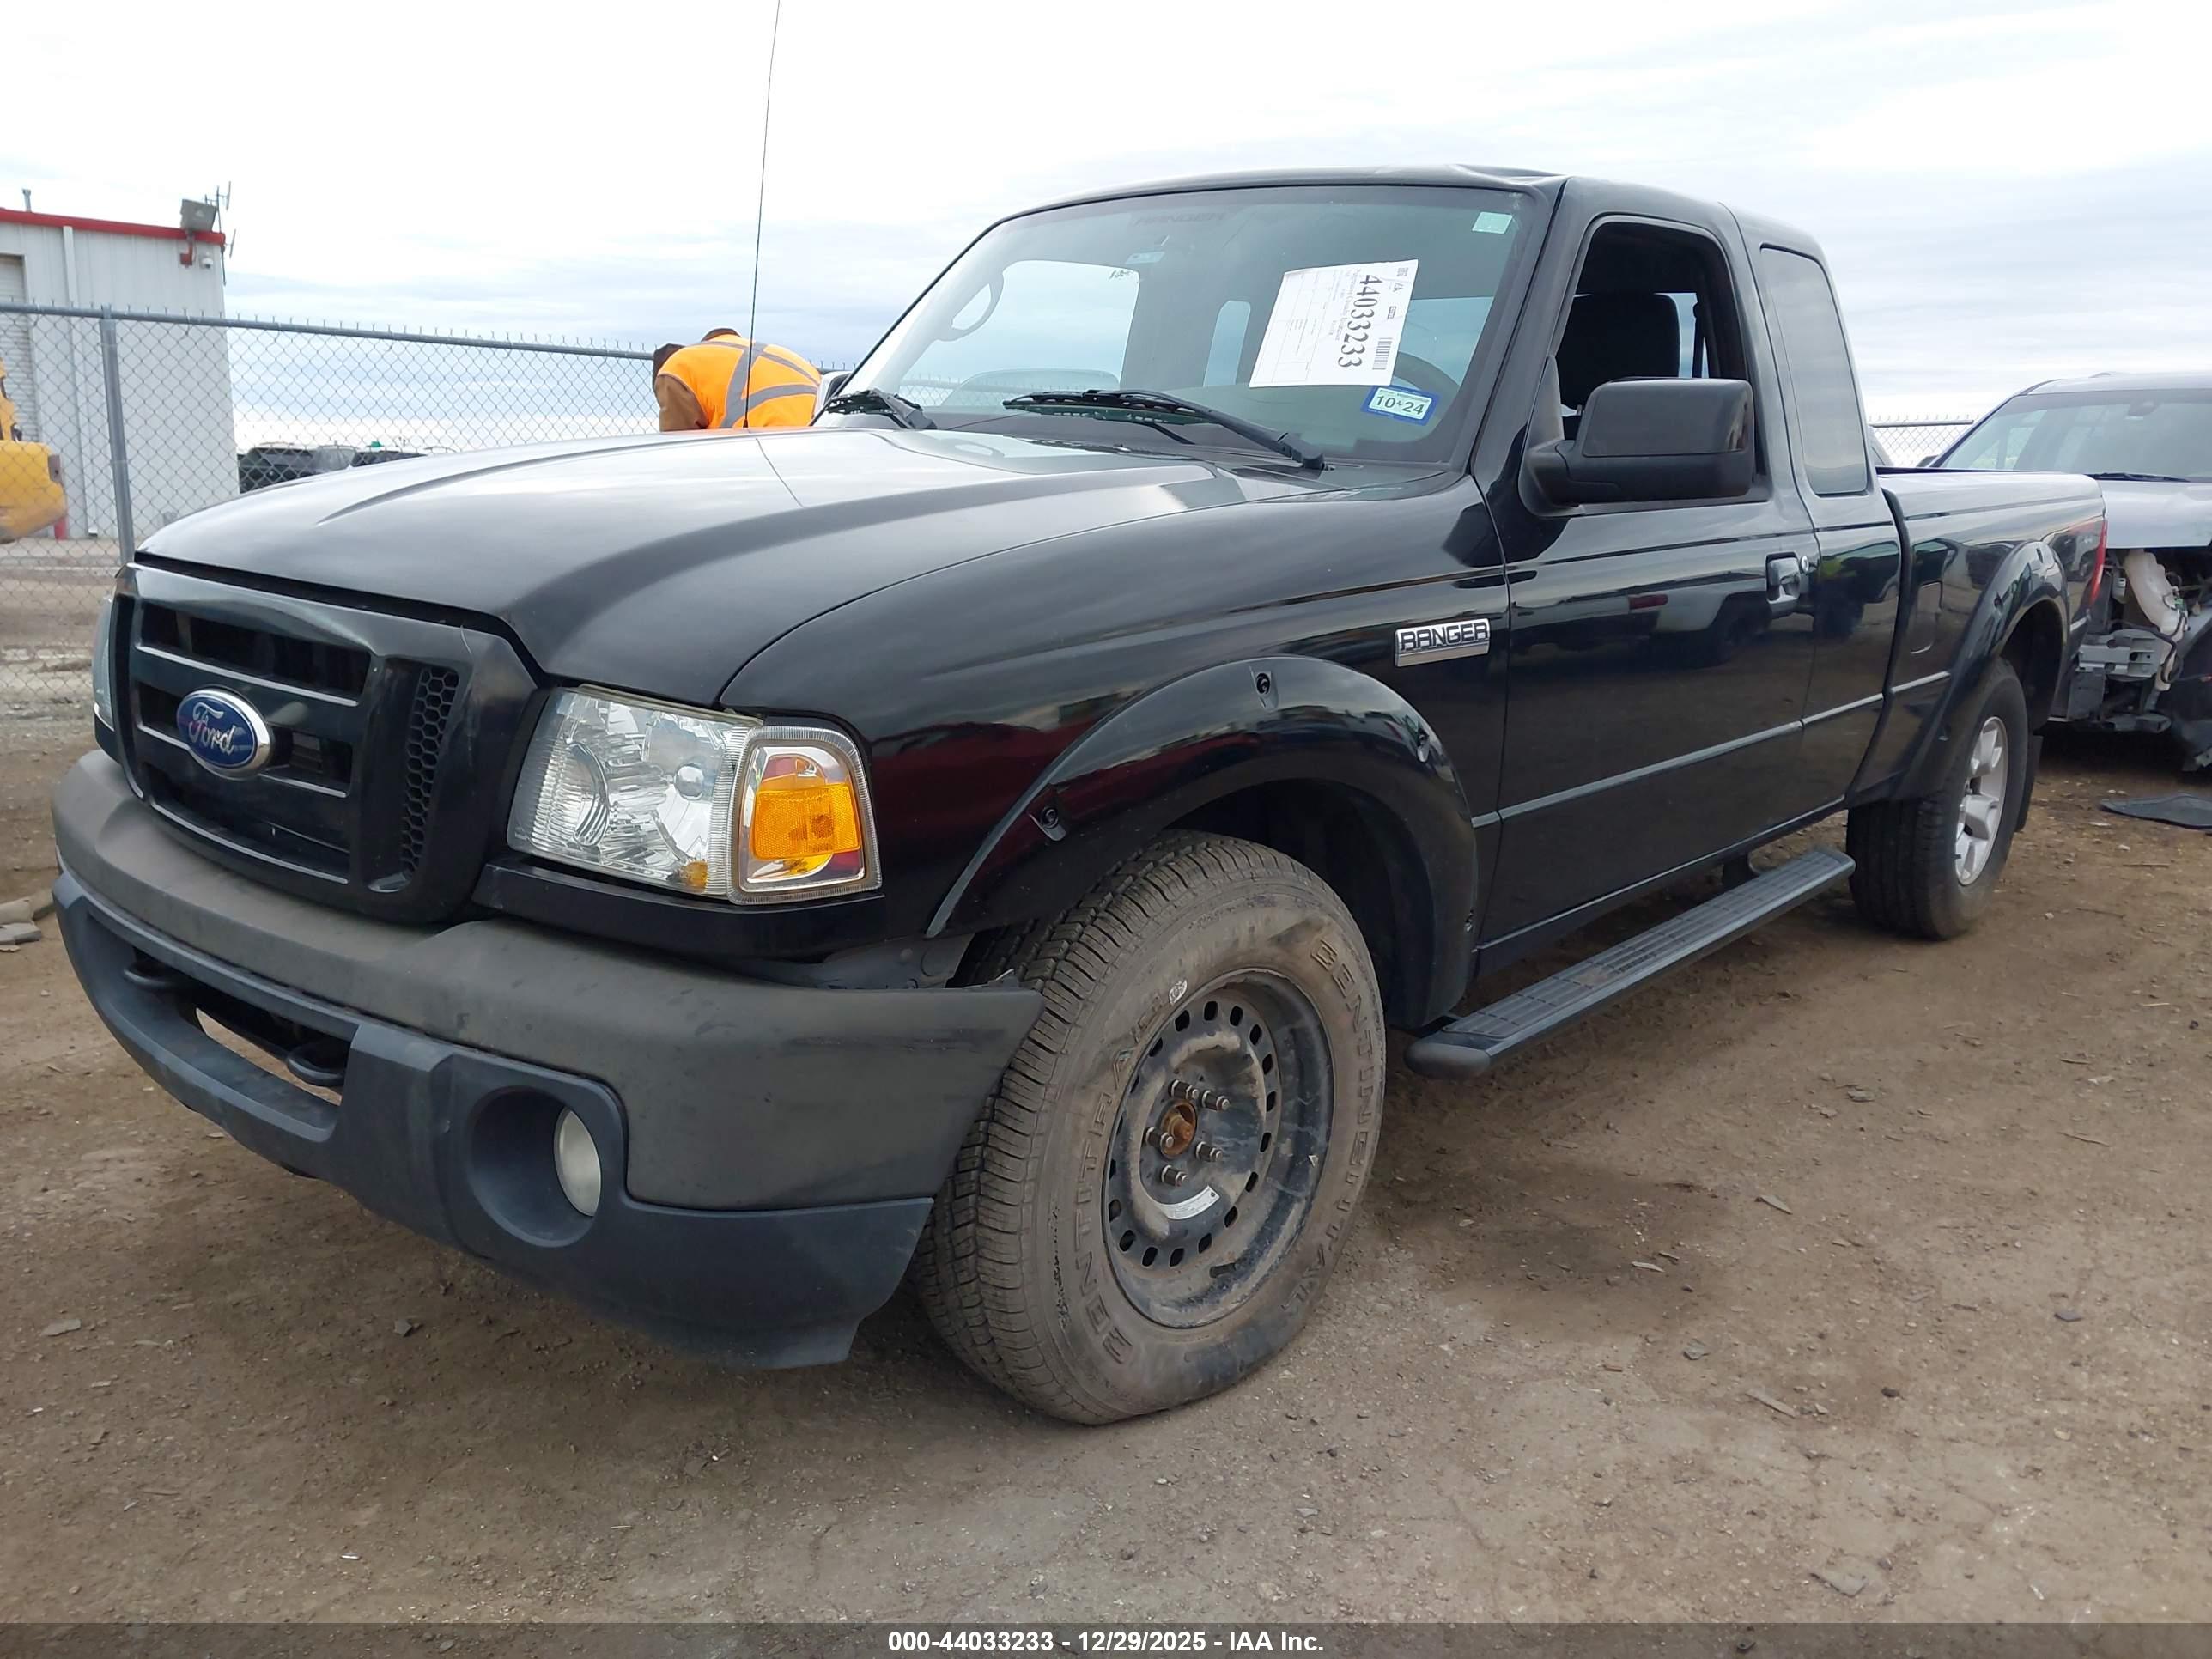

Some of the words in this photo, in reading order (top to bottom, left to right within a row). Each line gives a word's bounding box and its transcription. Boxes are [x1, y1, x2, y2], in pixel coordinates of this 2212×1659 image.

[1338, 274, 1383, 368] 44033233
[1376, 395, 1396, 409] 10
[1401, 401, 1425, 416] 24
[1400, 621, 1489, 652] RANGER
[189, 702, 237, 756] Ford
